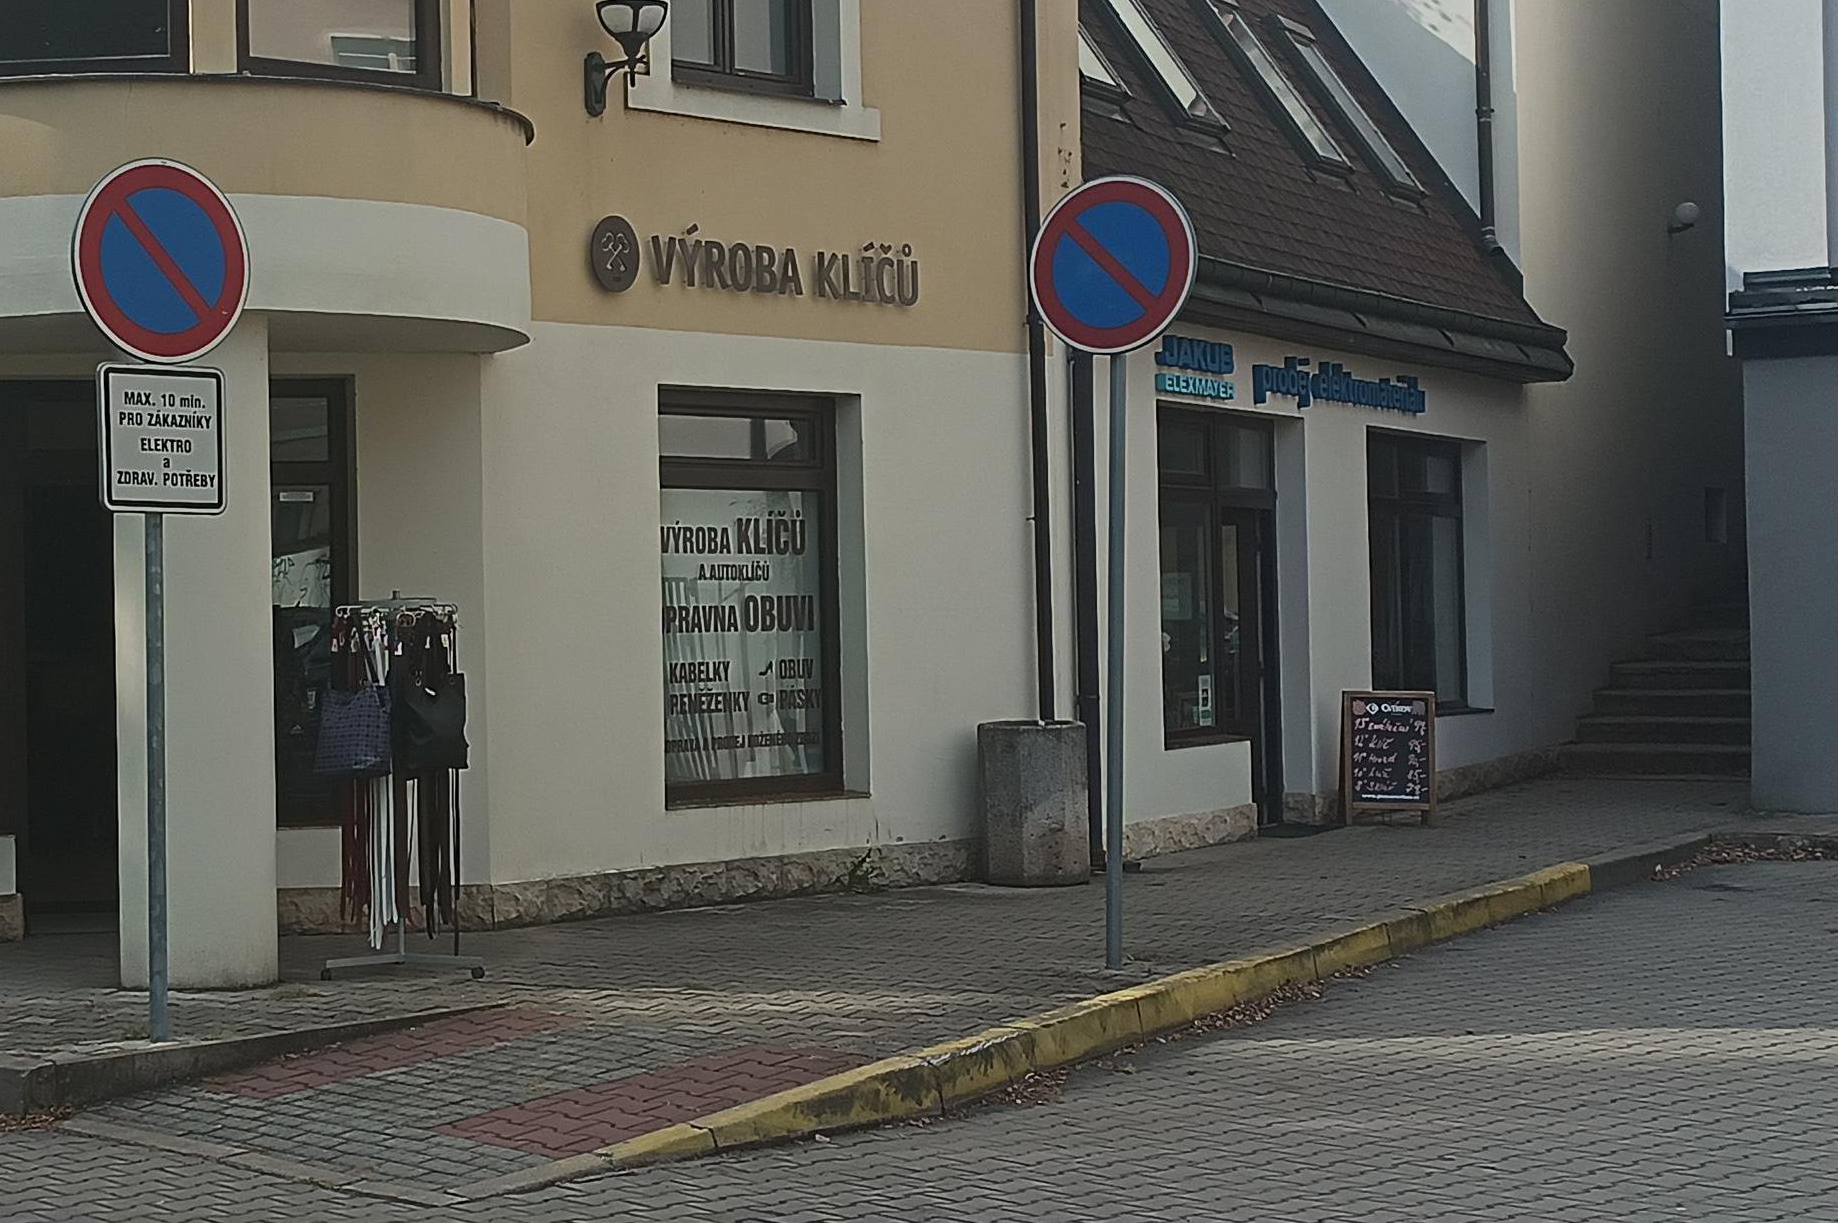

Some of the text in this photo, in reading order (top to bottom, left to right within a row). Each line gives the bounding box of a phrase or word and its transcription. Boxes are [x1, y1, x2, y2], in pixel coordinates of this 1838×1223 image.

[651, 224, 919, 307] VÝROBA KLÍČŮ
[1163, 335, 1235, 374] JAKUB
[1164, 373, 1235, 399] ELEXMAYER
[124, 391, 206, 409] MAX. 10 min.
[119, 410, 212, 430] PRO ZÁKAZNÍKY
[140, 437, 192, 454] ELEKTRO
[163, 457, 171, 469] a
[117, 470, 216, 488] ZDRAV. POTŘEBY
[660, 509, 806, 556] VÝROBA KLÍČŮ
[698, 561, 770, 582] A AUTOKLÍČŮ
[662, 594, 815, 634] PRAVNA OBUVI
[669, 658, 814, 684] KABELKY OBUV
[669, 685, 823, 716] PENĚŽENKY PÁSKY
